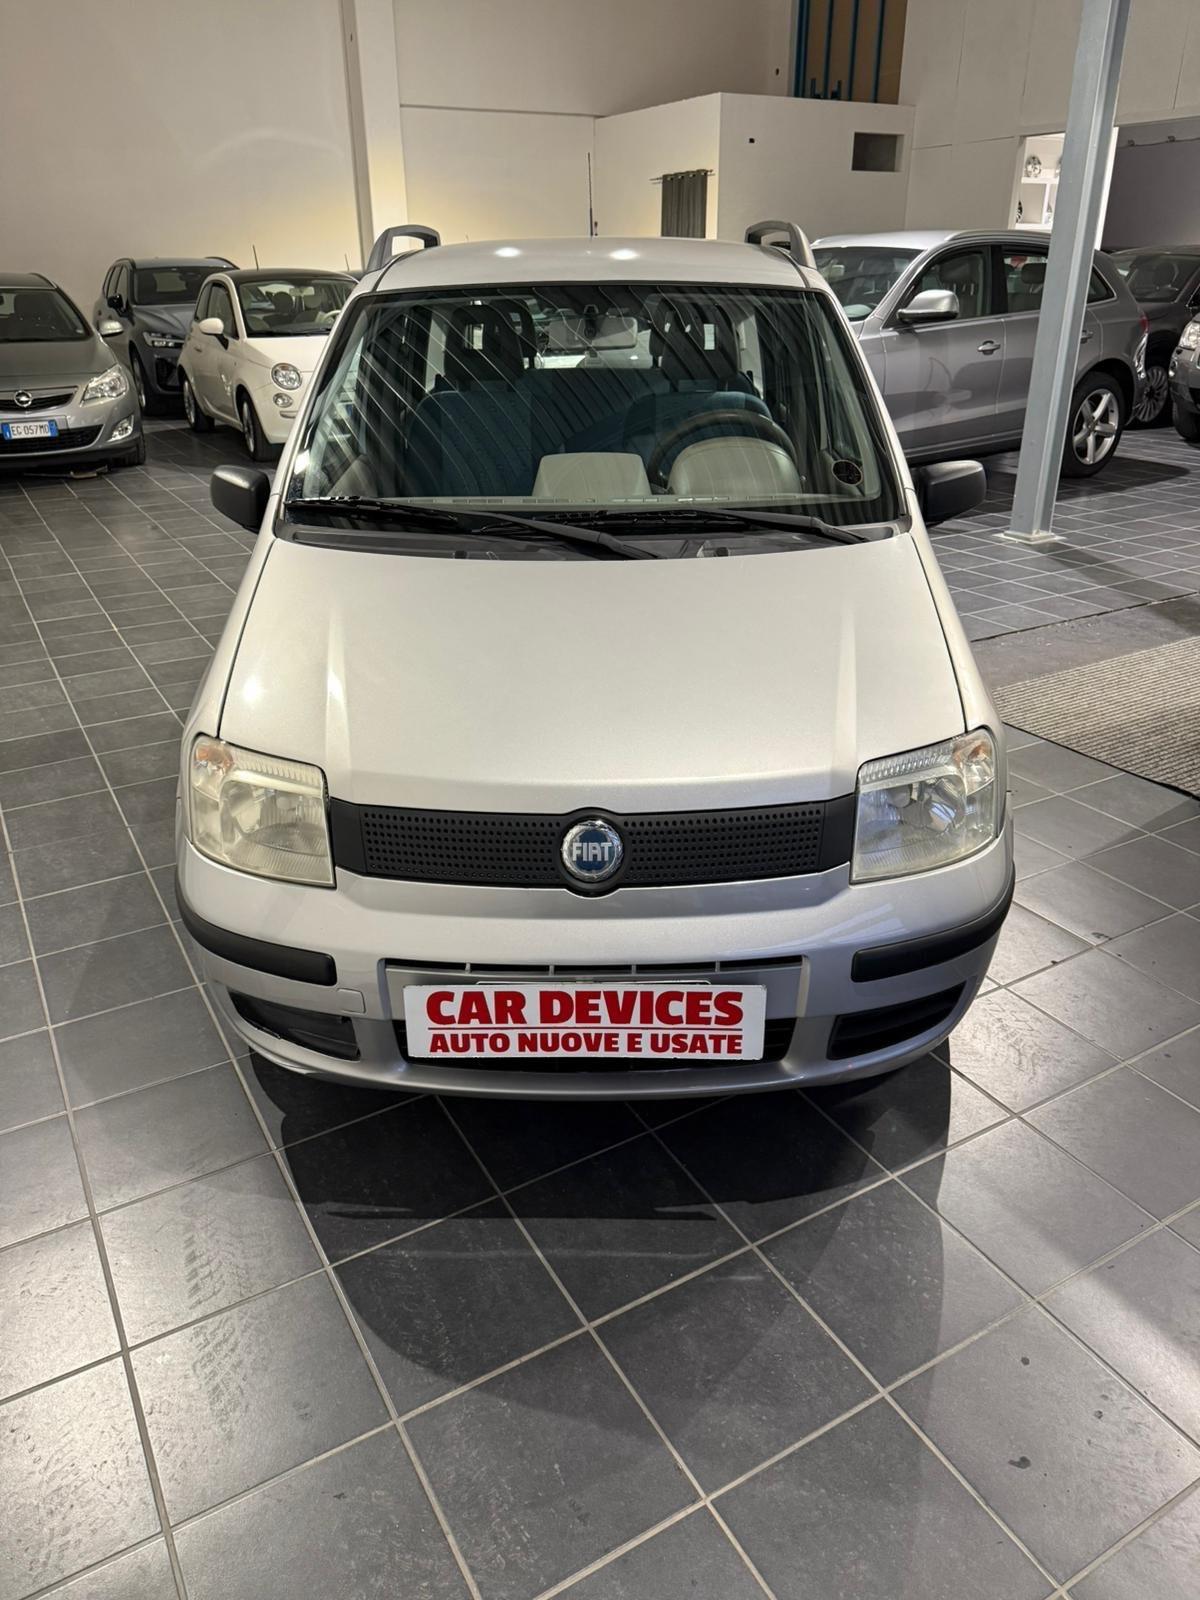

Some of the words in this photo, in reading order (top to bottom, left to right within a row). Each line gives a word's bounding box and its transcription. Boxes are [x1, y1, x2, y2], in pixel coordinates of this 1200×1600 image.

[572, 842, 612, 862] FIAT
[426, 990, 526, 1026] CAR
[539, 990, 744, 1026] DEVICES
[429, 1032, 511, 1054] AUTO
[518, 1032, 619, 1054] NUOVE
[627, 1032, 641, 1054] E
[650, 1032, 743, 1055] USATE
